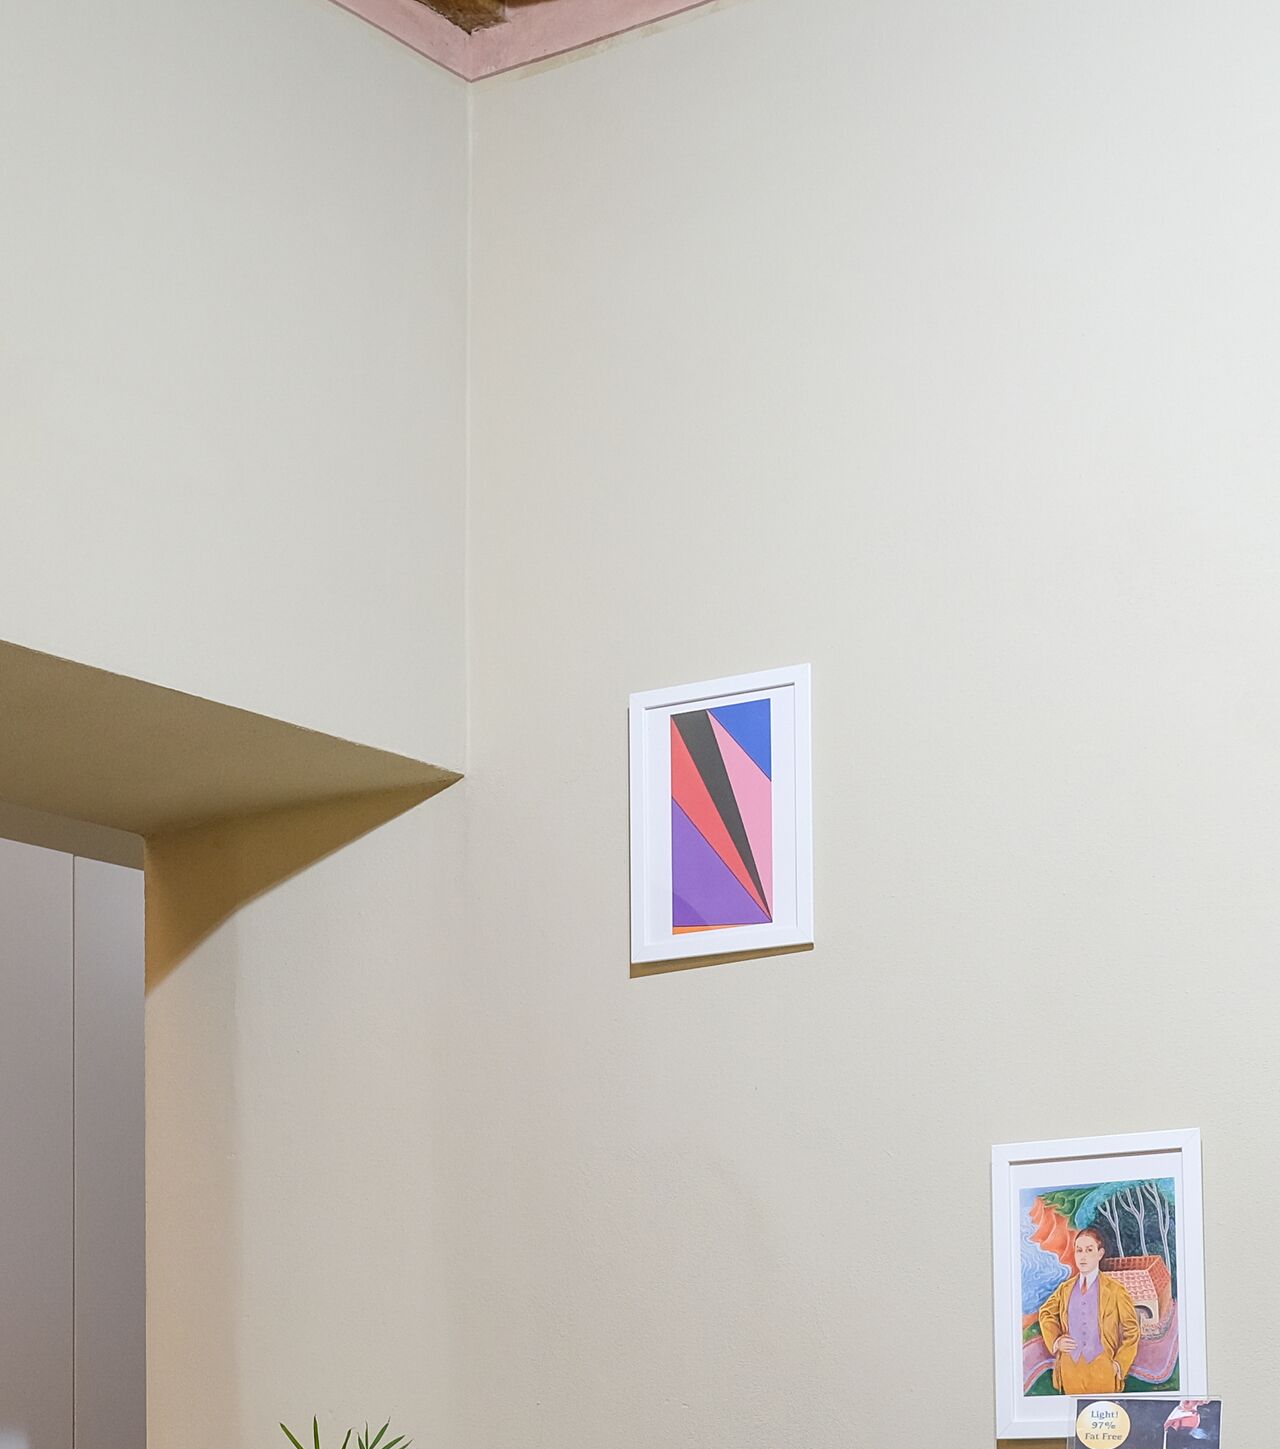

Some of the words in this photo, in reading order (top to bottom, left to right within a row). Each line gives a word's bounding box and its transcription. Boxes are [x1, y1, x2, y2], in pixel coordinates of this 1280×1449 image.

[1090, 1409, 1119, 1419] Light!
[1091, 1421, 1116, 1430] 97%
[1084, 1432, 1101, 1441] Fat
[1102, 1432, 1123, 1441] Free
